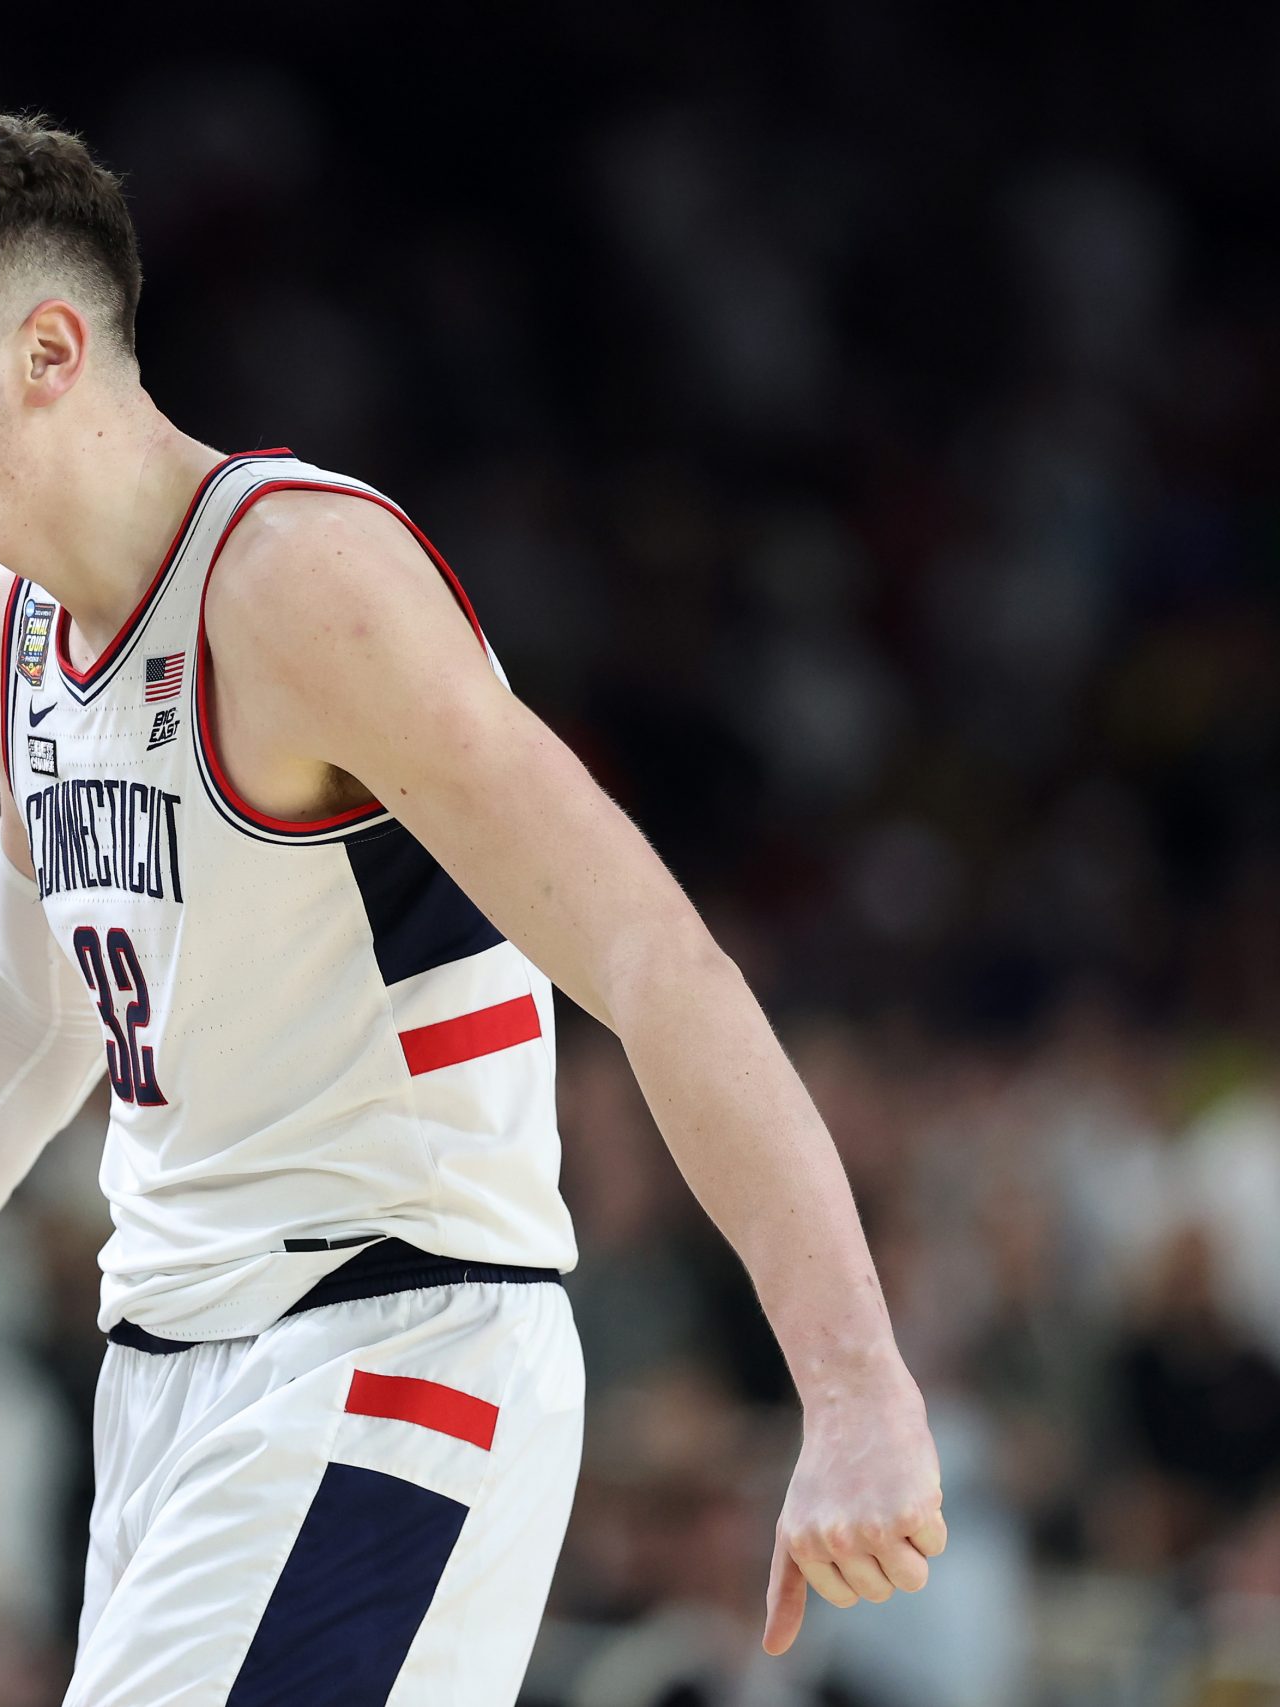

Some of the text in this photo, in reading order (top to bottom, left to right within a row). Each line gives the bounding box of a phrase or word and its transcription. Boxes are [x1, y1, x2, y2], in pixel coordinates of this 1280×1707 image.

[26, 617, 49, 635] FINAL
[23, 635, 46, 652] FOUR
[153, 707, 177, 728] BIG
[149, 720, 180, 743] EAST
[25, 779, 184, 905] CONNECTICUT
[73, 926, 168, 1107] 32
